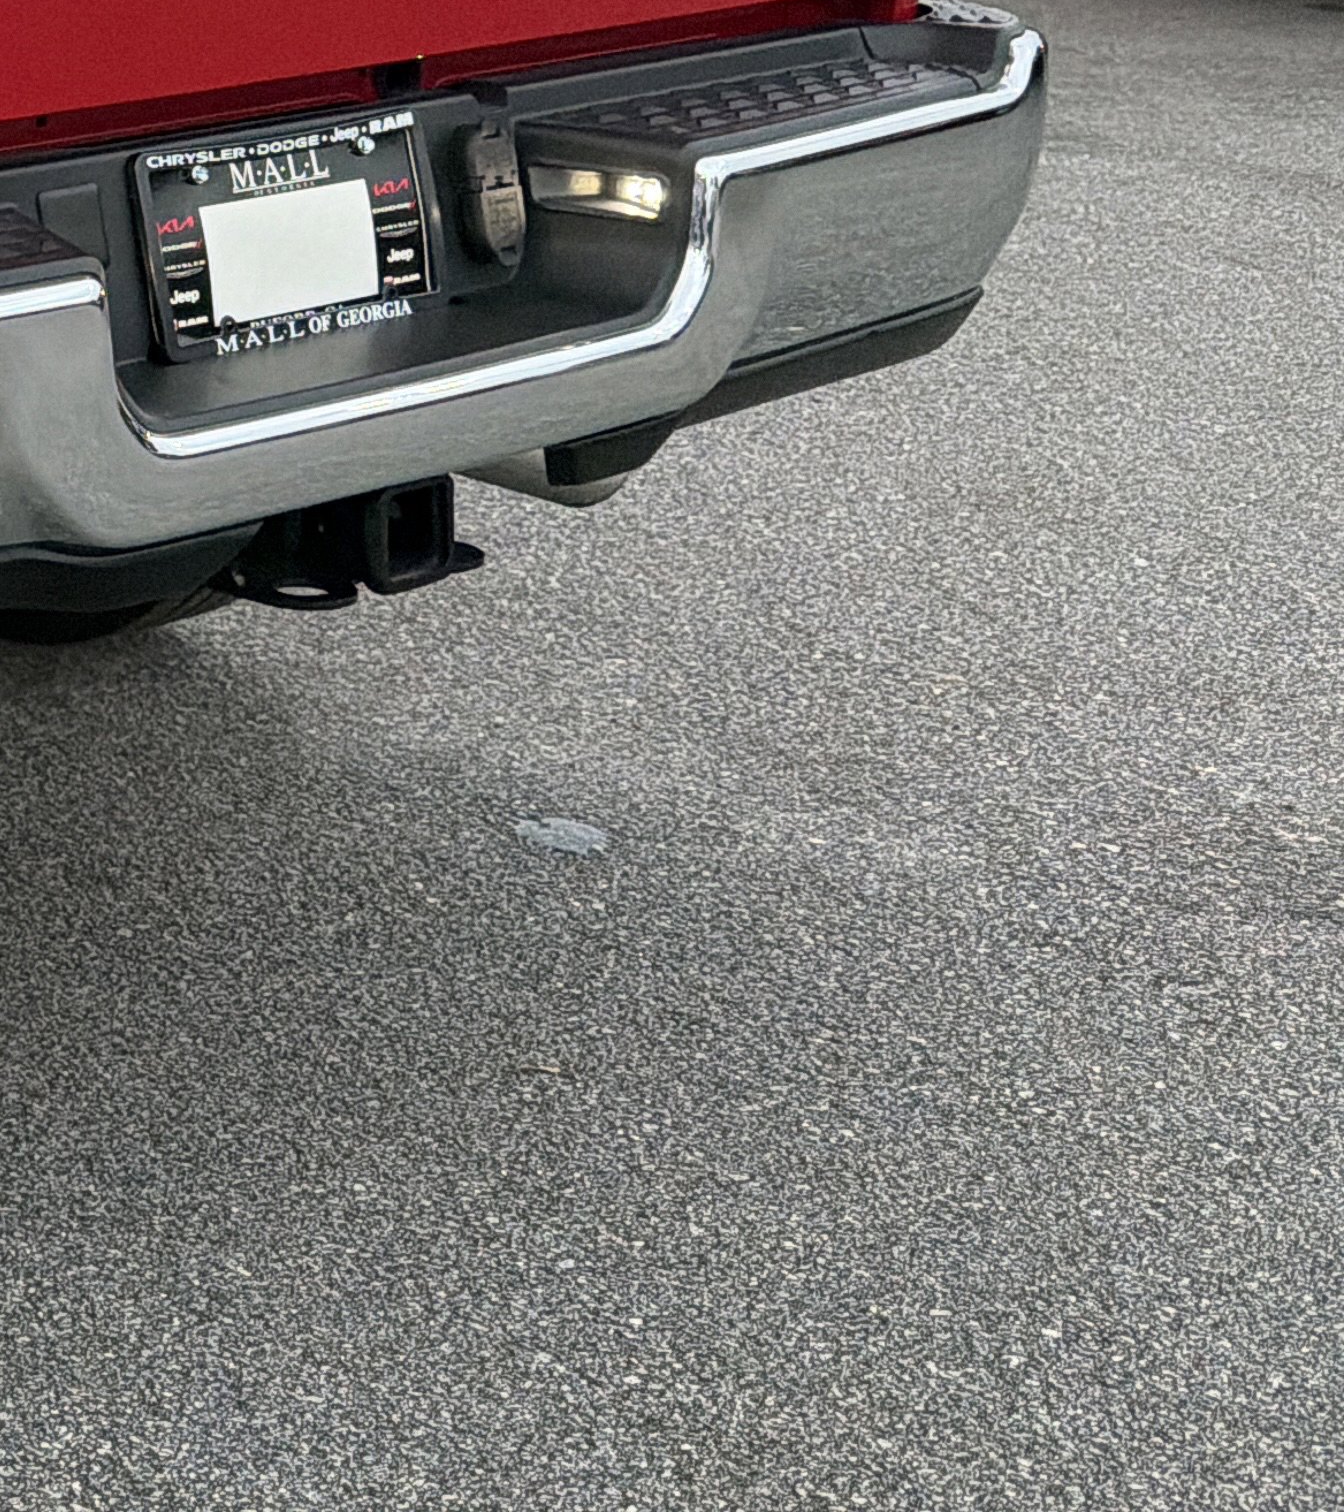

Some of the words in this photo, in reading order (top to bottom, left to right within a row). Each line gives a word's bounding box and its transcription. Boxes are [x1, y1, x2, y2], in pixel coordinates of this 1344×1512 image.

[145, 146, 248, 170] CHRYSLER
[256, 134, 321, 156] DODGE
[329, 126, 361, 144] Jeep
[369, 111, 415, 135] RAM
[386, 248, 415, 264] Jeep
[169, 289, 201, 305] Jeep
[307, 314, 333, 335] OF
[336, 298, 414, 329] GEORGIA
